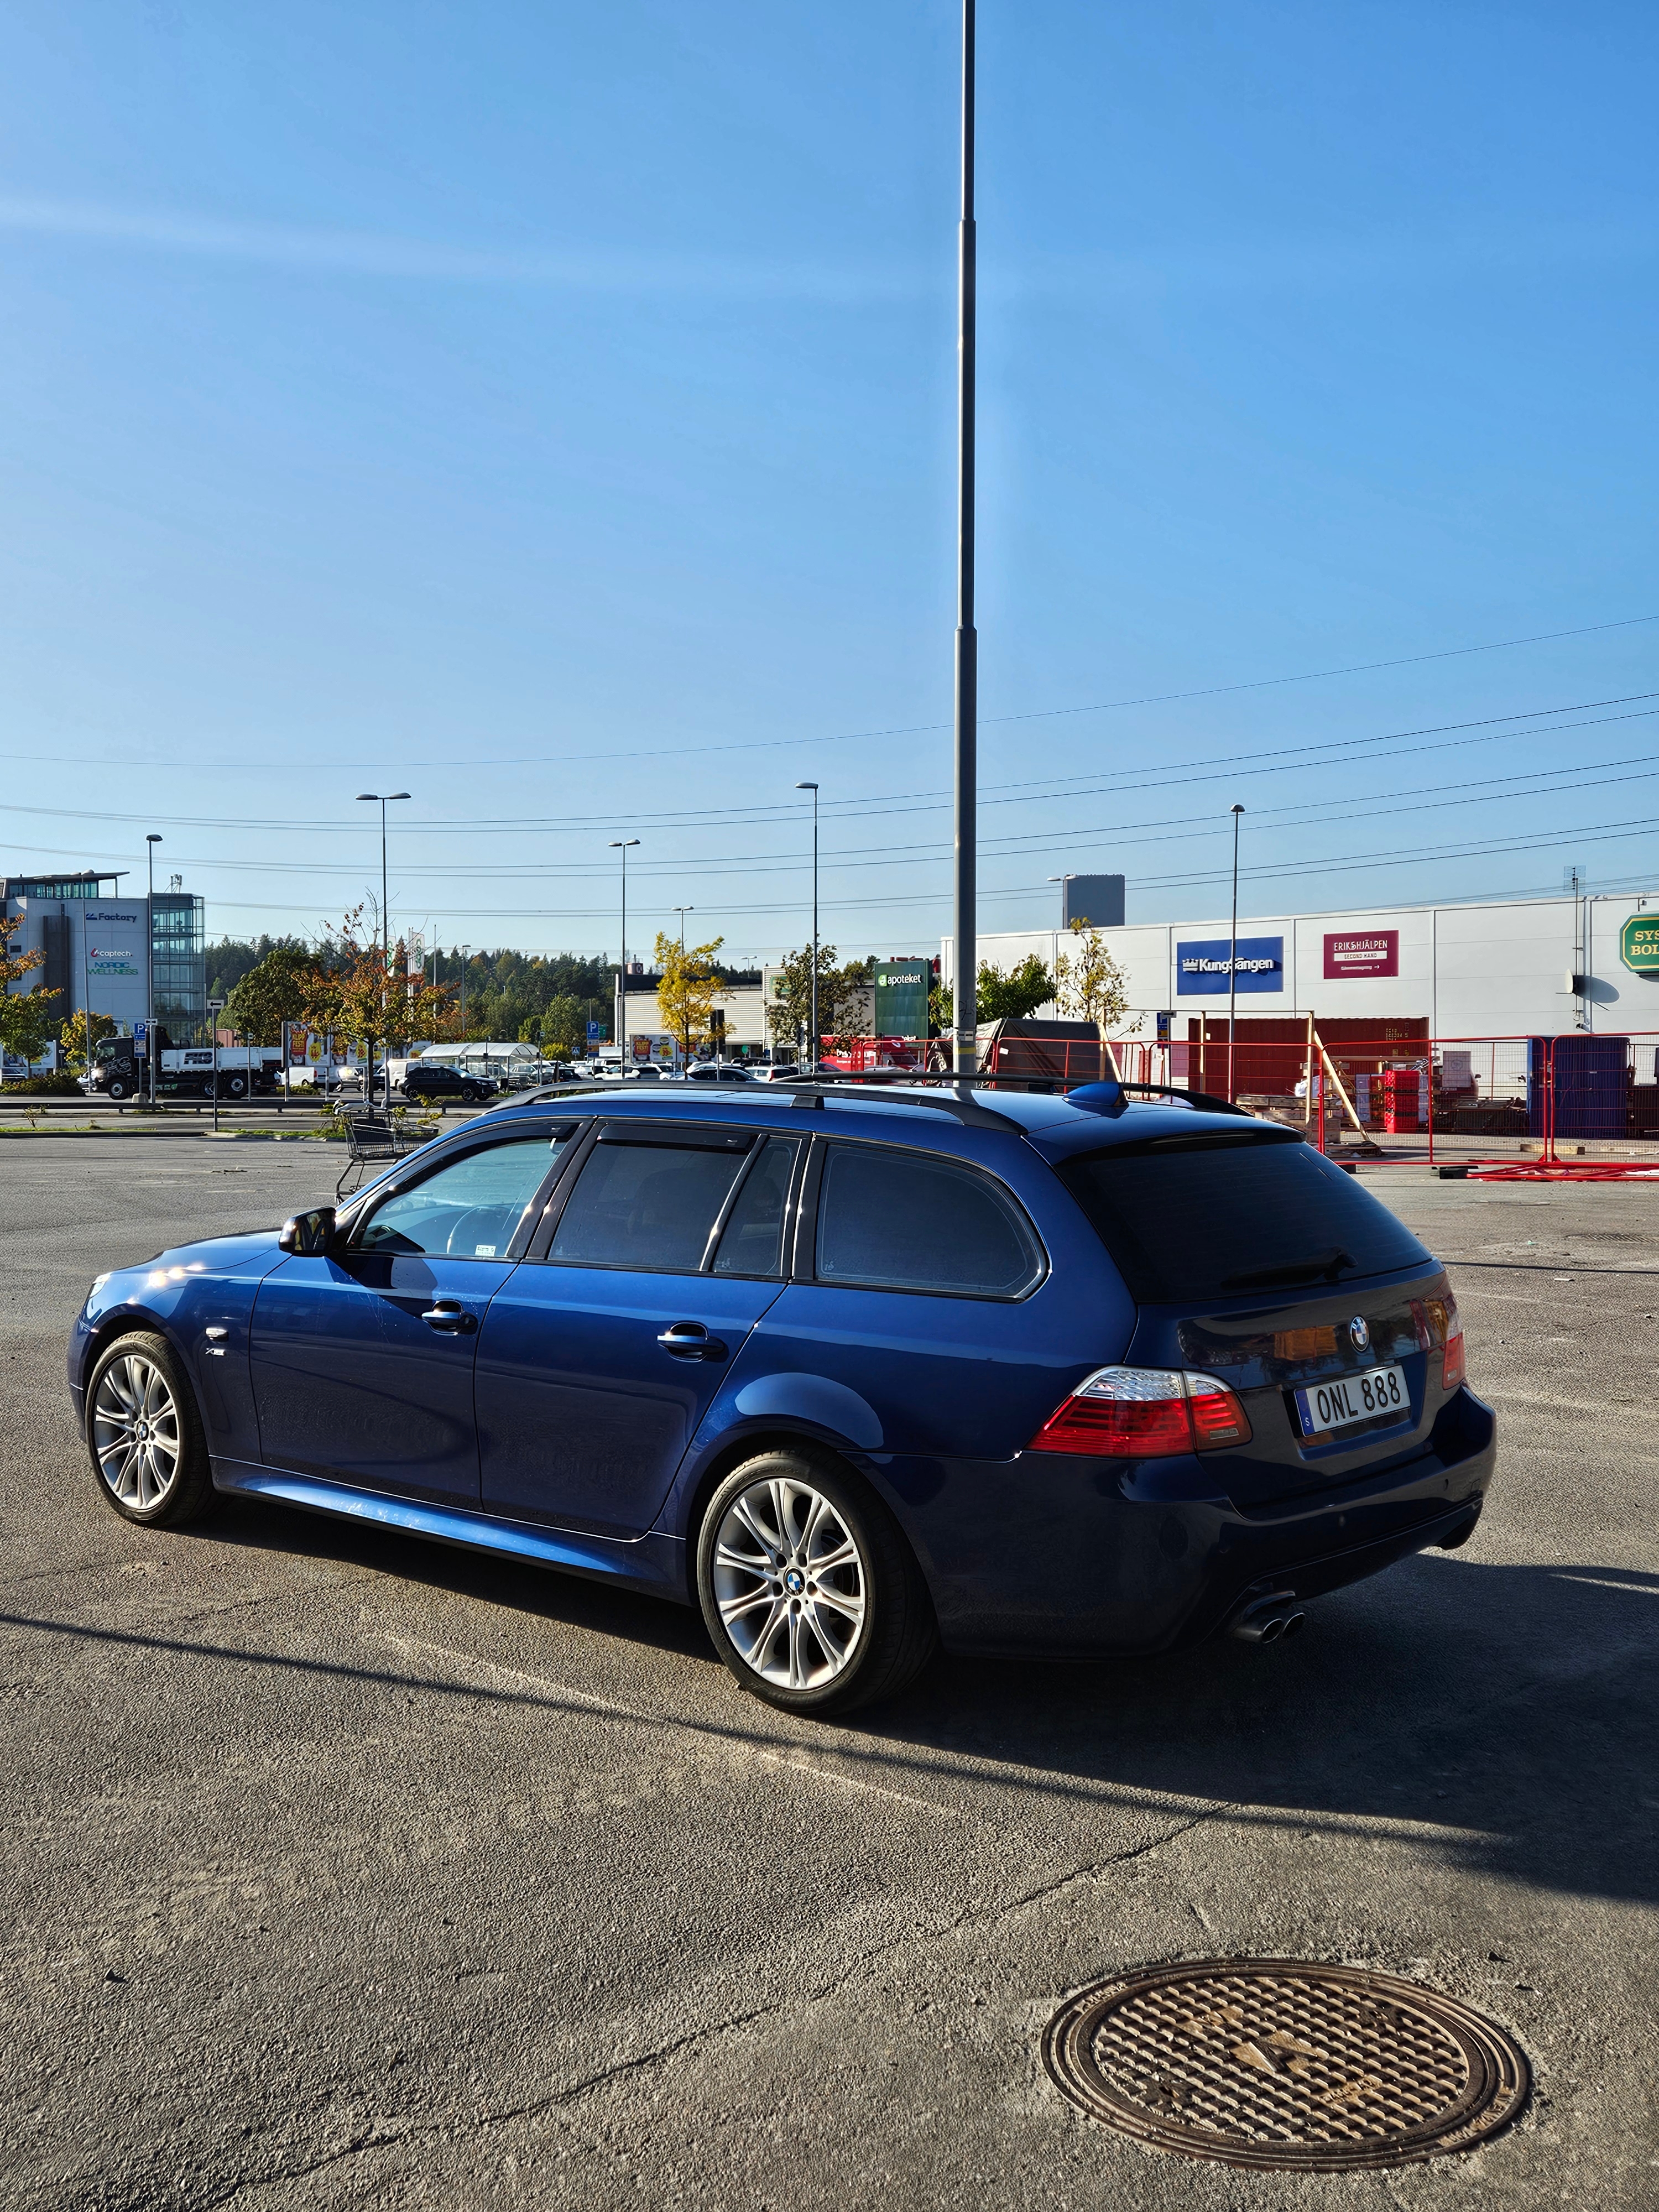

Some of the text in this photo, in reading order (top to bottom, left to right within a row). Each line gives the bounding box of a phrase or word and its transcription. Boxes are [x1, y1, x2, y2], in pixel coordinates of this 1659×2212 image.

[99, 913, 137, 922] Factory
[1334, 940, 1387, 951] ERIKSHJÄLPEN
[888, 973, 921, 986] apoteket
[138, 1024, 144, 1034] P
[590, 1022, 597, 1032] P
[1317, 1372, 1400, 1424] ONL 888
[1305, 1417, 1310, 1426] S
